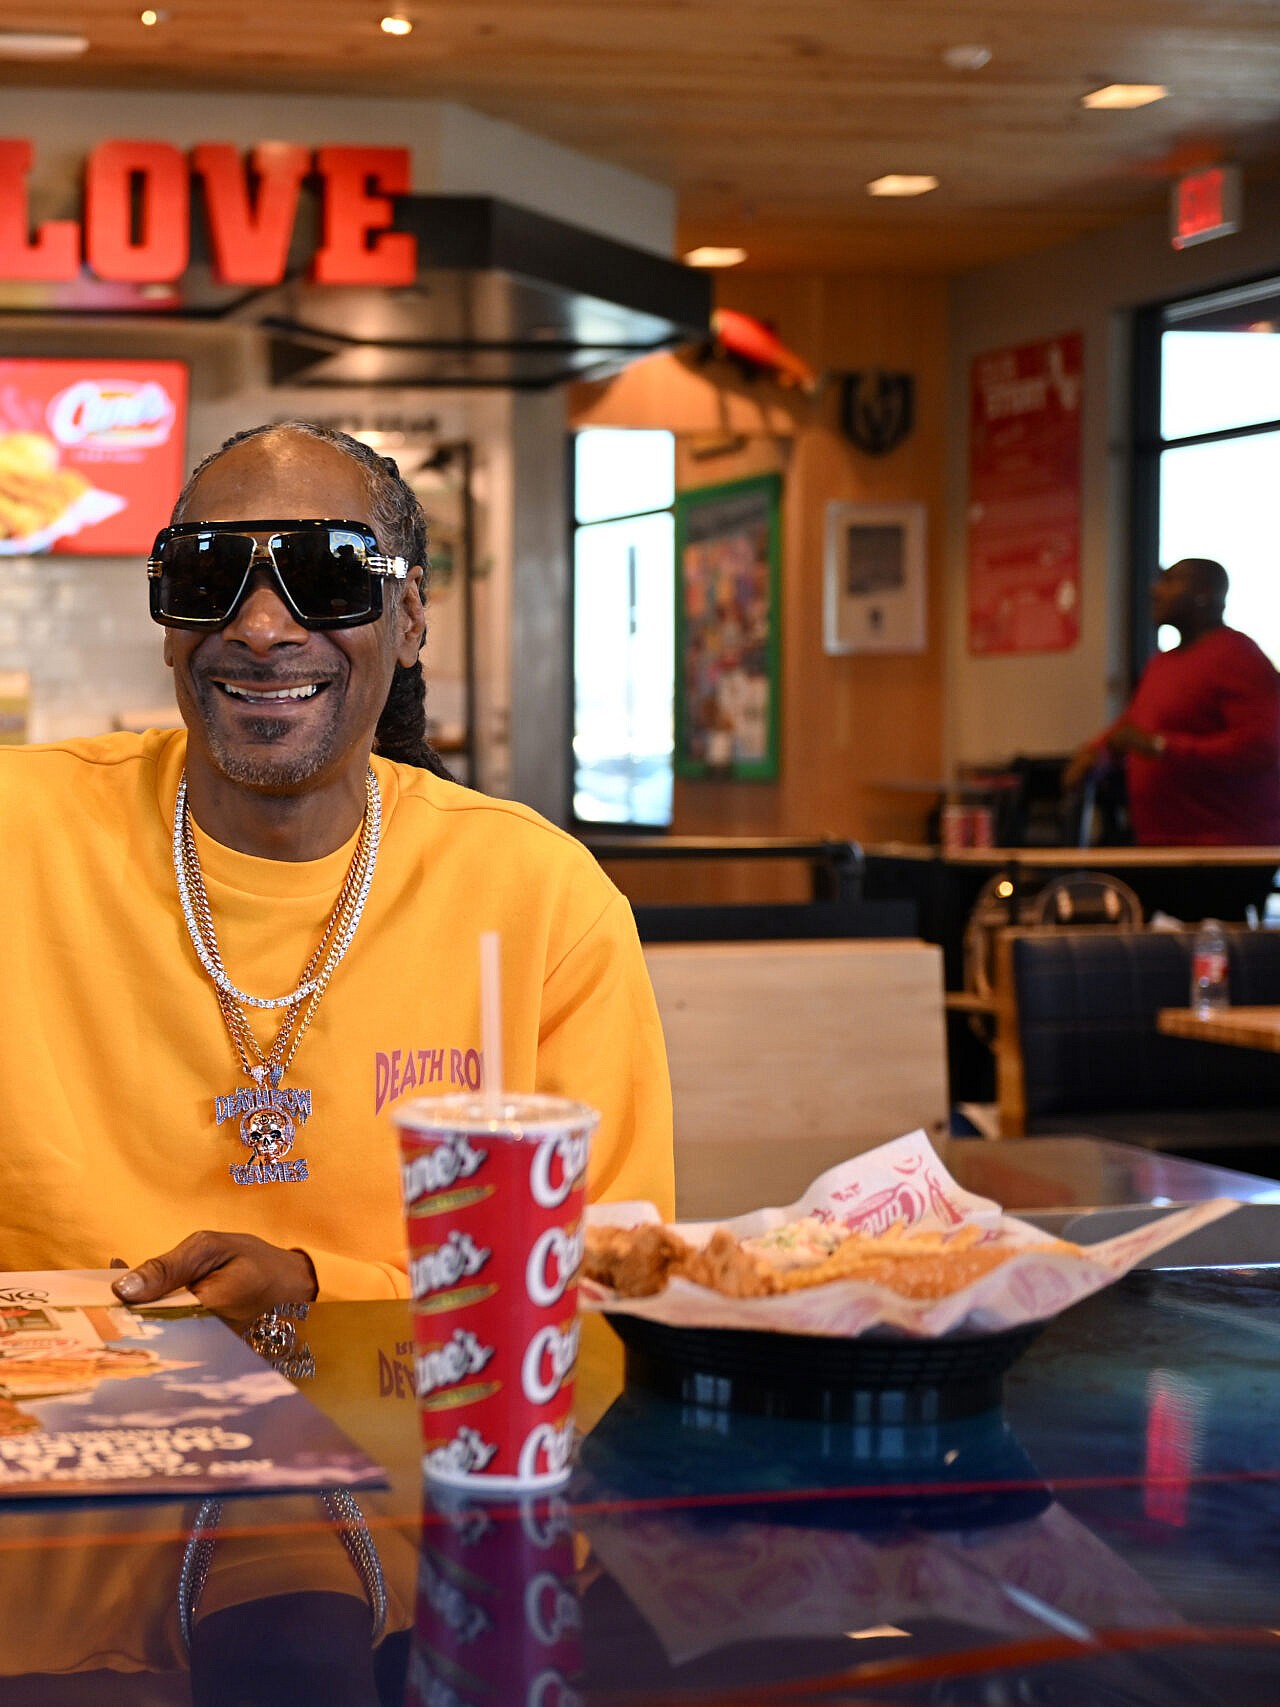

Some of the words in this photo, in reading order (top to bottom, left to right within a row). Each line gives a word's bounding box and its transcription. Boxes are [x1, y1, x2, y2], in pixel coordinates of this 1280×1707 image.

[375, 1048, 445, 1117] DEATH
[450, 1048, 485, 1091] RO
[215, 1087, 270, 1126] DEATH
[270, 1086, 313, 1128] ROW
[231, 1158, 310, 1185] GAMES
